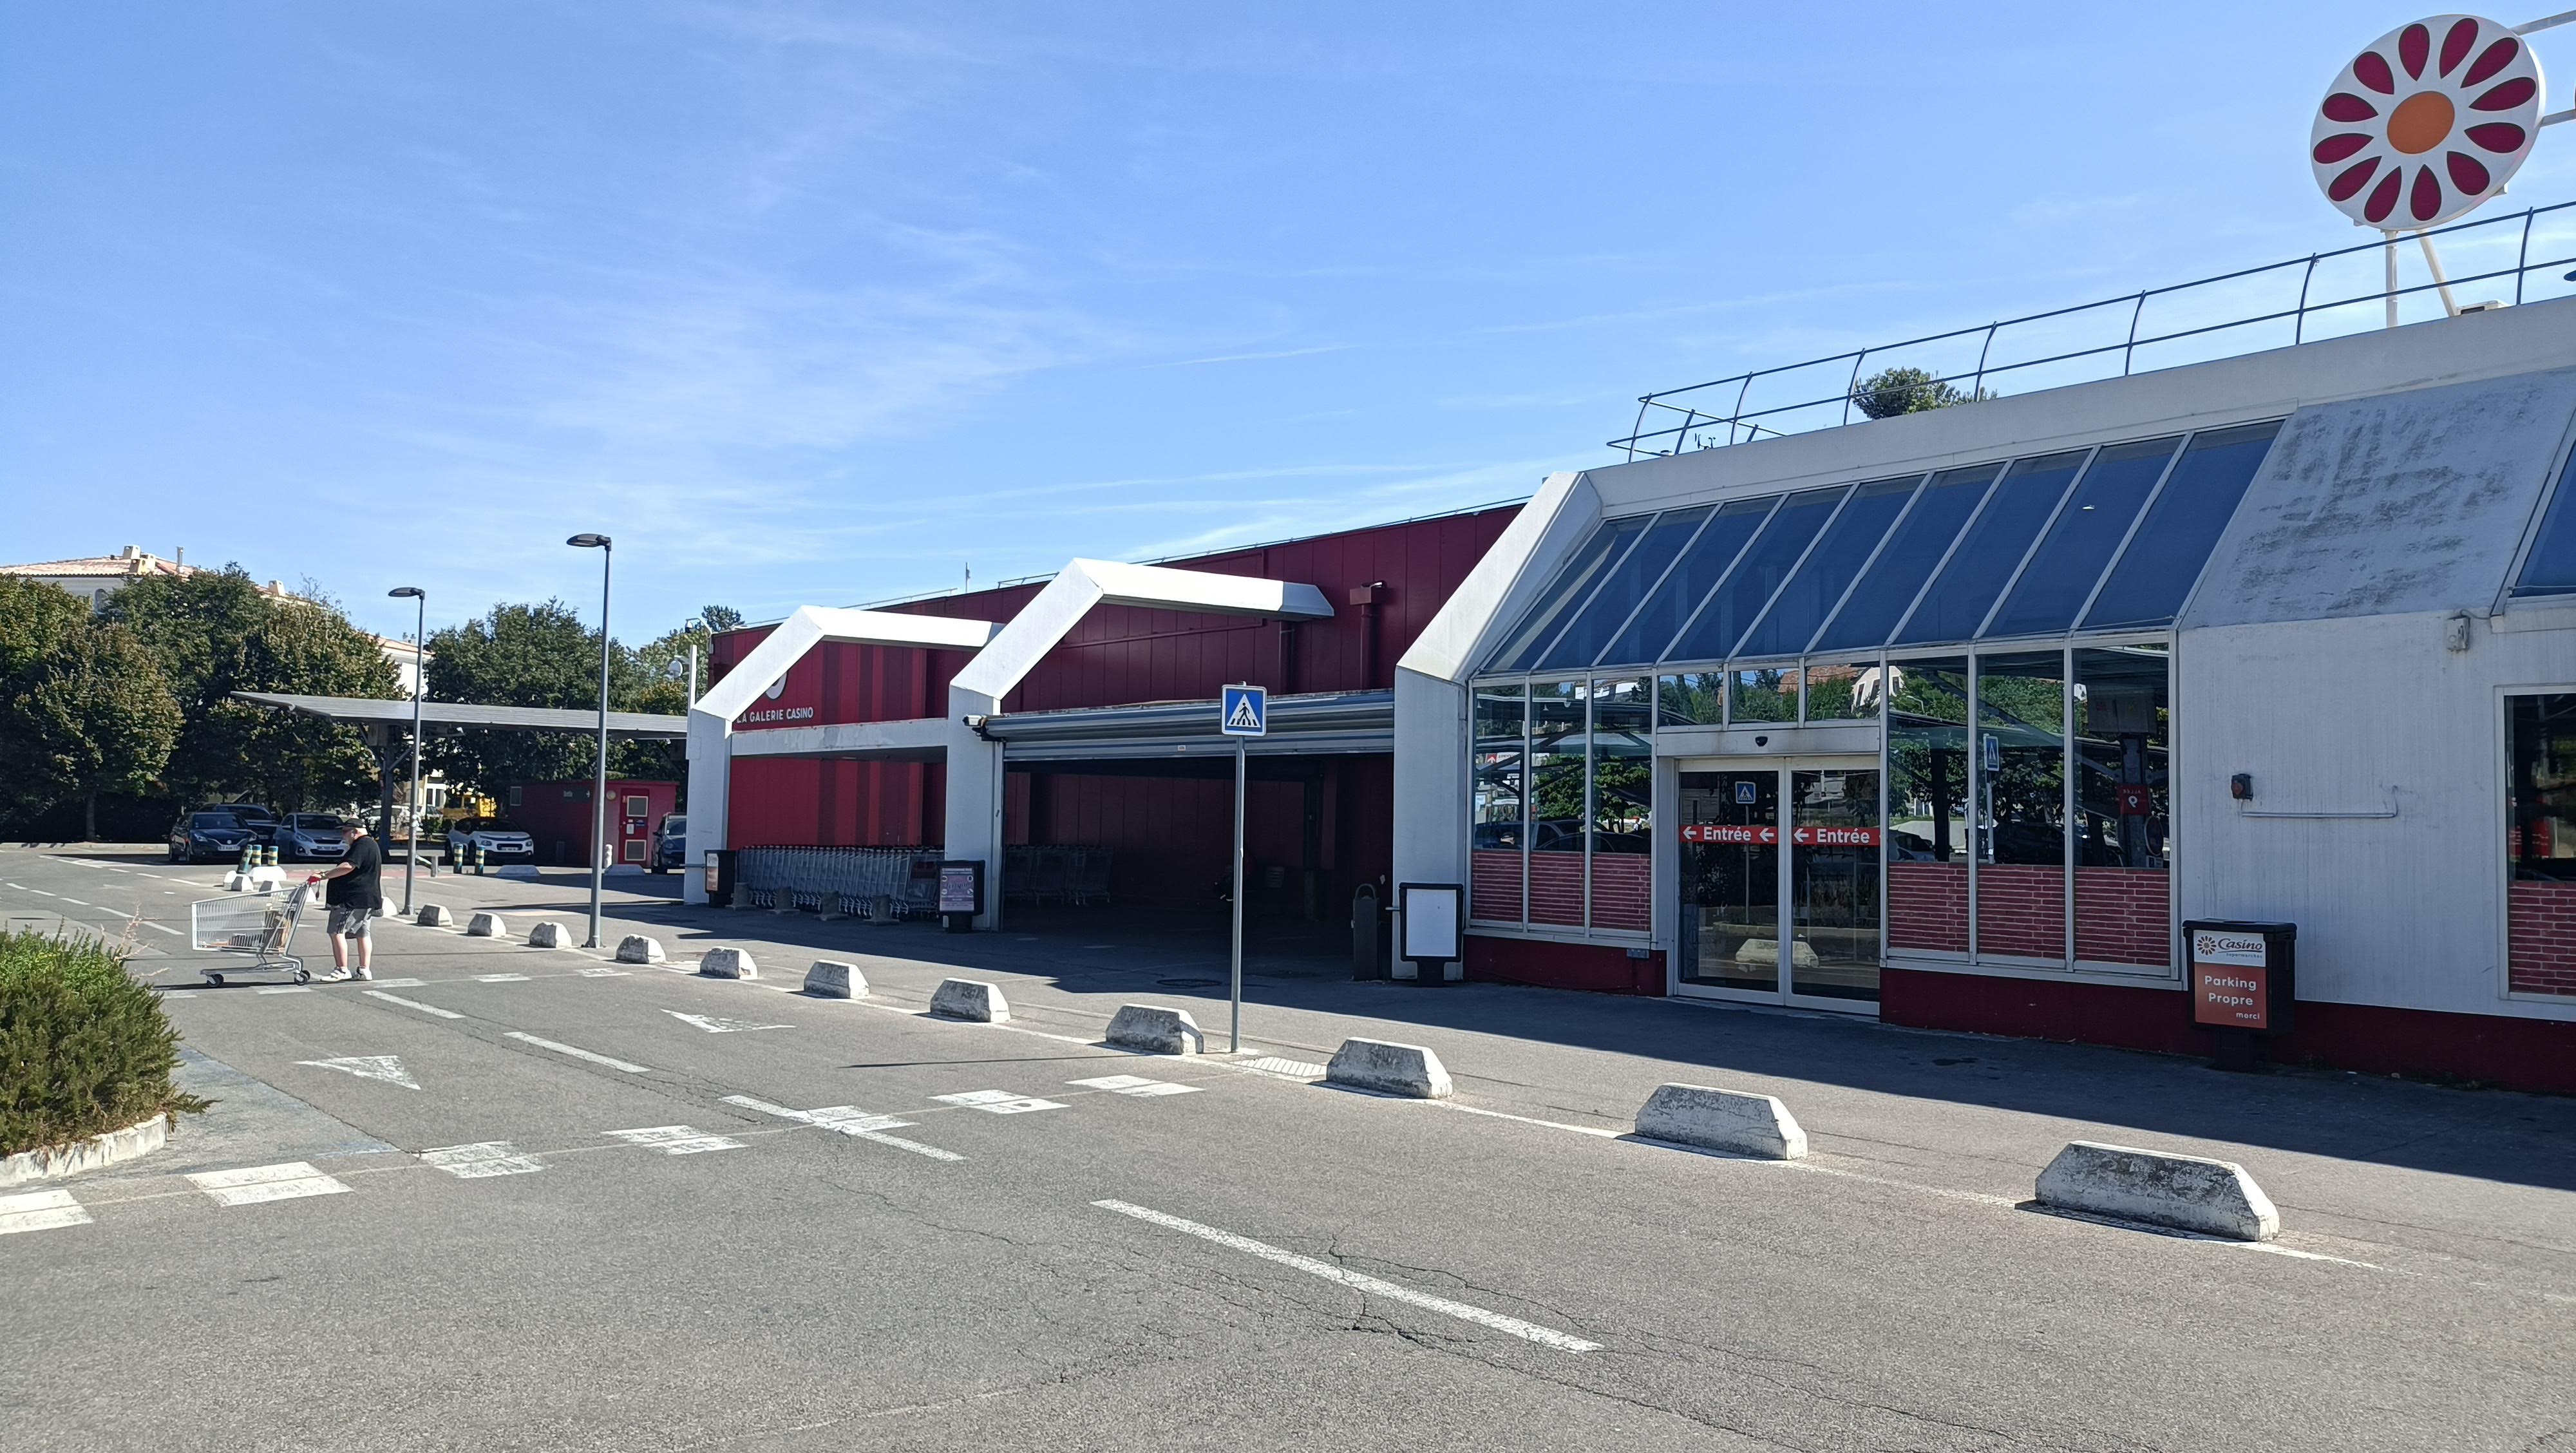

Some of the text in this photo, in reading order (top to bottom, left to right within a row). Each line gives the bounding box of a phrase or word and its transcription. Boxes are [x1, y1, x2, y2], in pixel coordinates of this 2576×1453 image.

[750, 710, 784, 722] GALERIE
[786, 707, 813, 719] CASINO
[1703, 826, 1752, 841] Entrée
[1817, 828, 1870, 843] Entrée
[2218, 938, 2263, 951] Casino
[2205, 975, 2257, 991] Parking
[2208, 992, 2253, 1006] Propre
